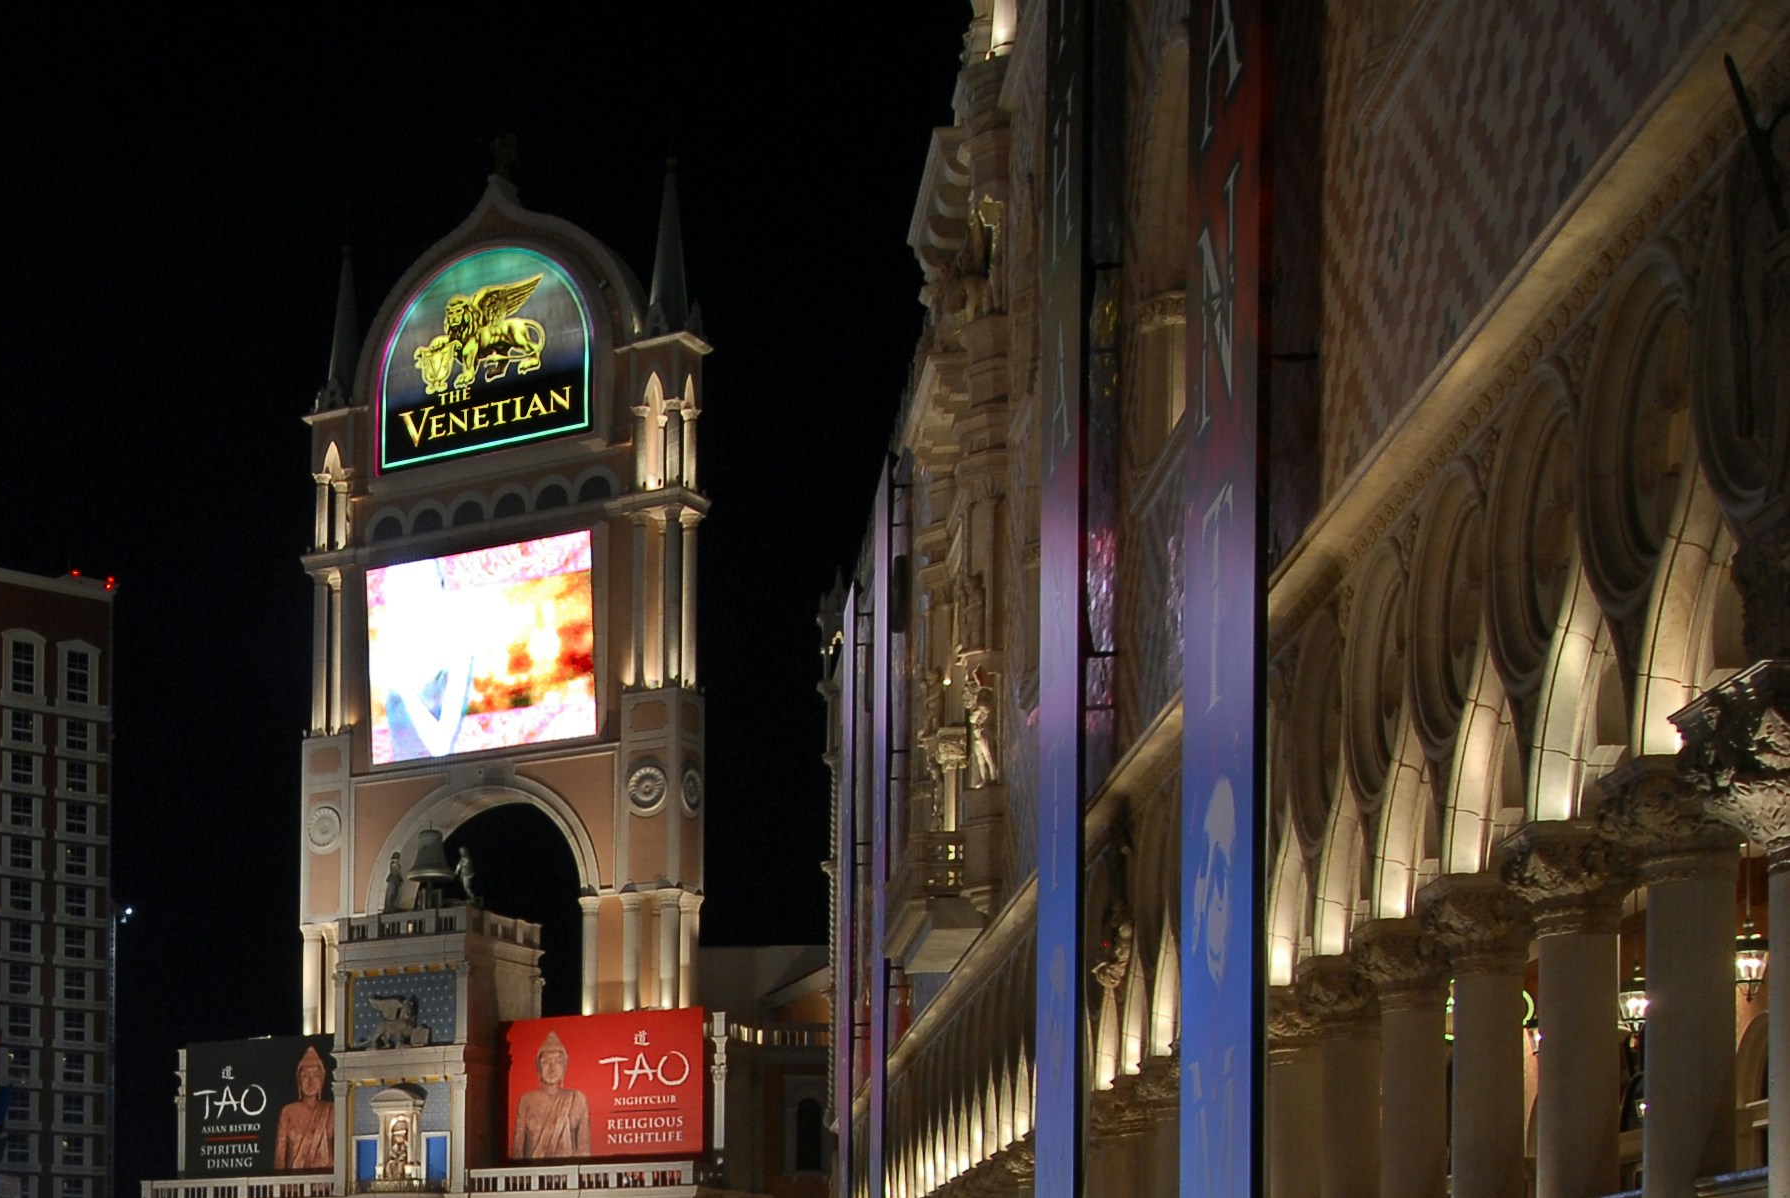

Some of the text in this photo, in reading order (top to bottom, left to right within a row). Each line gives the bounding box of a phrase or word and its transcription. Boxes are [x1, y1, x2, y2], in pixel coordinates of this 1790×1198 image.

[439, 387, 472, 406] THE
[398, 386, 572, 448] VENETIAN
[599, 1050, 690, 1091] TAO
[193, 1084, 267, 1120] TAO
[613, 1095, 677, 1106] NIGHTCLUB
[201, 1122, 261, 1134] ASIAN BISTRO
[607, 1116, 684, 1131] RELIGIOUS
[607, 1131, 683, 1145] NIGHTLIFE
[200, 1143, 260, 1157] SPIRITUAL
[207, 1157, 253, 1169] DINING
